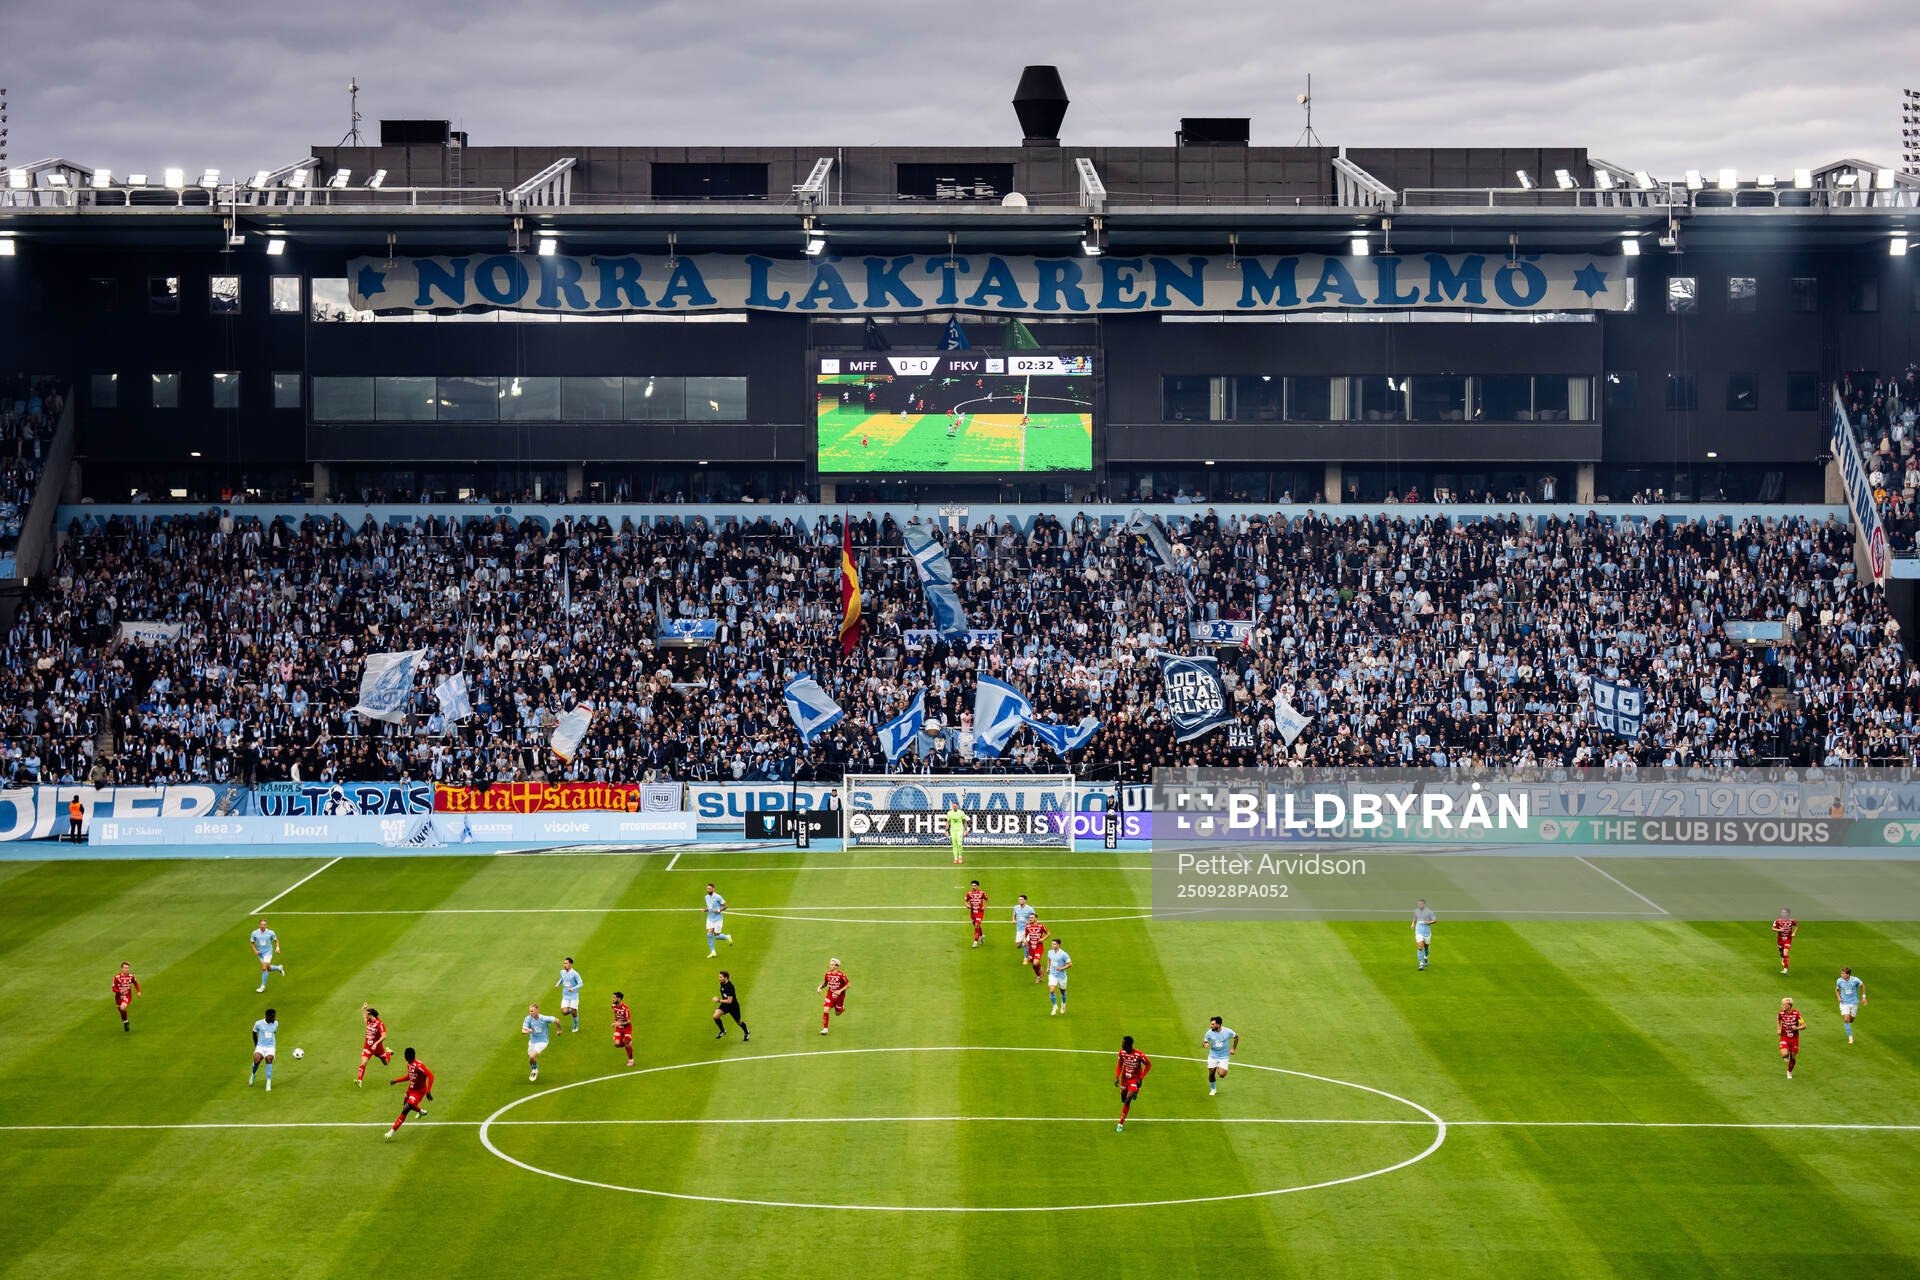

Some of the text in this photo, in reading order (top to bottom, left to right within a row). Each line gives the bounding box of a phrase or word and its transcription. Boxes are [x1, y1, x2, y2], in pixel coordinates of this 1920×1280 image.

[414, 253, 1547, 311] NORRA LÄKTAREN MALMÖ
[849, 361, 878, 371] MFF
[900, 361, 907, 371] 0
[920, 361, 928, 371] 0
[949, 361, 979, 371] IFKV
[1017, 360, 1054, 371] 02:32
[1597, 788, 1778, 817] 24/2 1910
[195, 823, 229, 834] akea
[544, 820, 590, 833] visolve
[903, 815, 948, 834] THE
[1027, 815, 1049, 835] IS
[1107, 819, 1116, 848] SELECT
[1589, 820, 1830, 844] THE CLUB IS YOURS
[904, 837, 918, 846] pris
